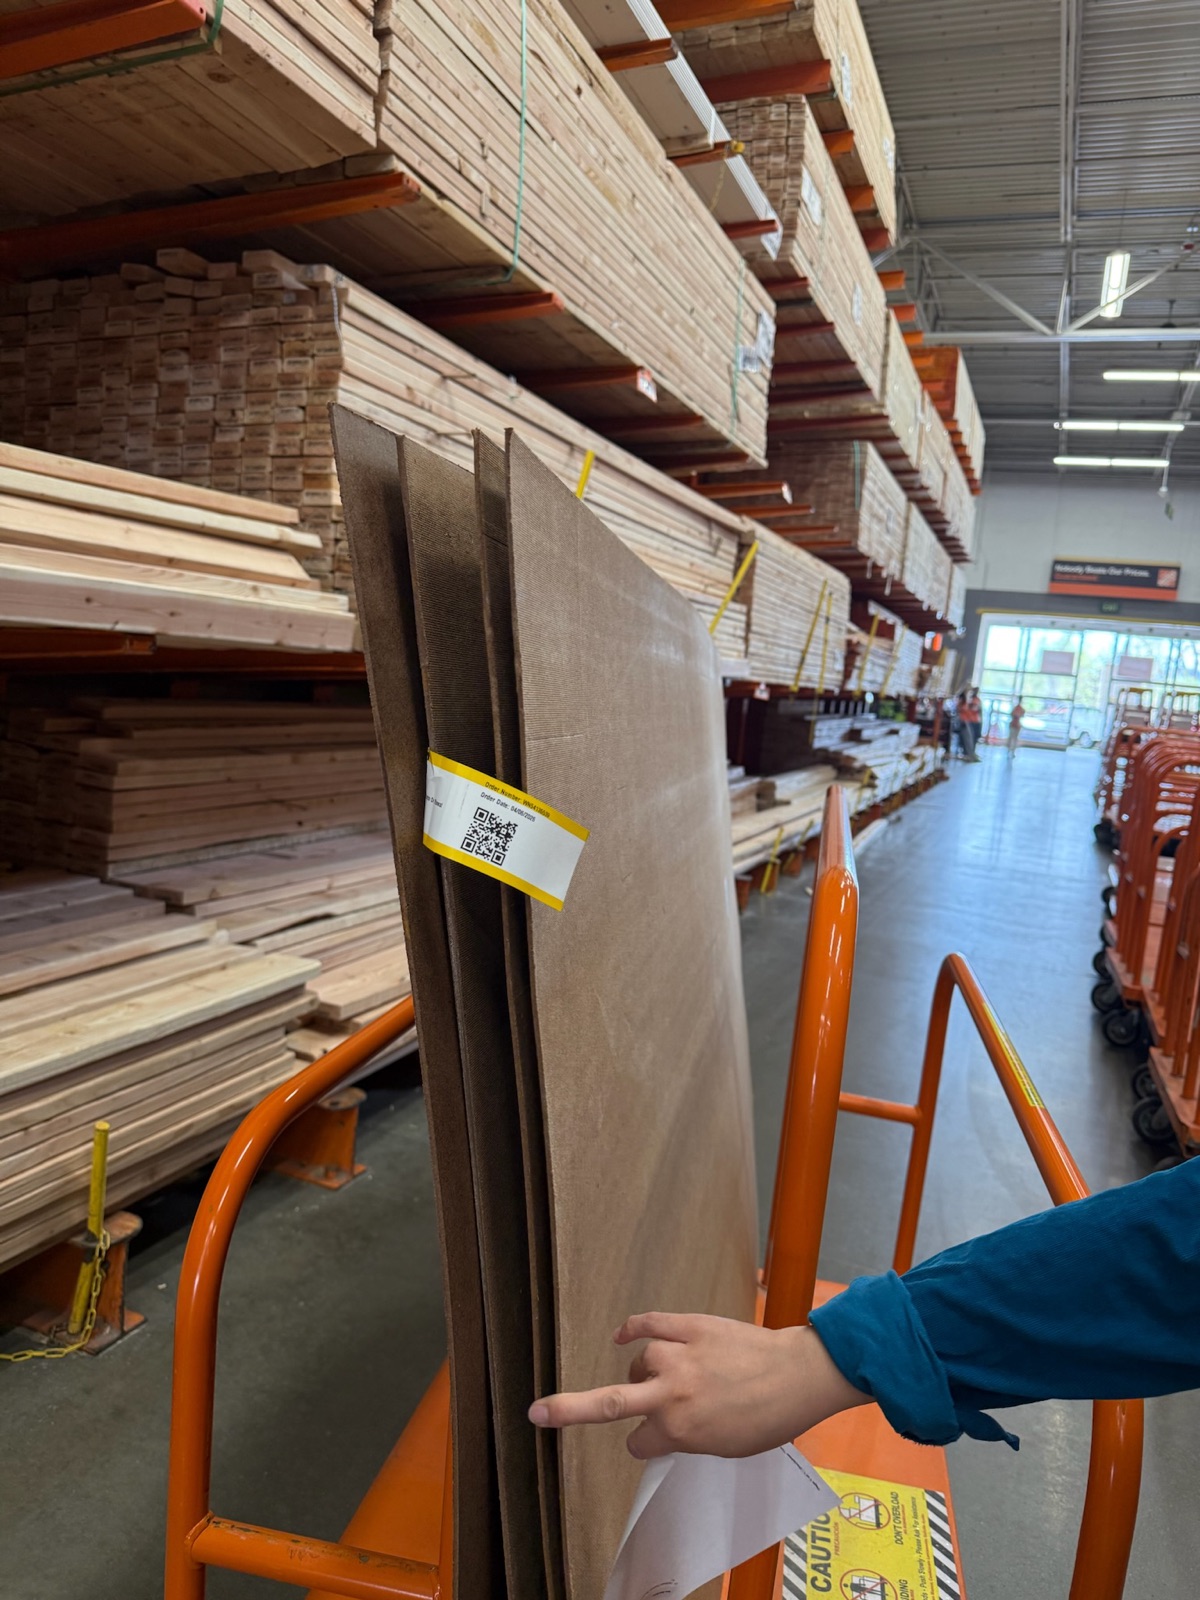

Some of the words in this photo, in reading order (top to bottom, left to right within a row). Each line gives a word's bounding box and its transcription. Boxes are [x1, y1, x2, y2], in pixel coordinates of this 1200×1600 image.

[485, 782, 500, 793] Order
[480, 792, 496, 802] Order
[496, 799, 509, 810] Date:
[891, 1491, 902, 1525] OVERLOAD
[893, 1524, 904, 1545] DON'T
[918, 1558, 926, 1575] Slowly
[919, 1575, 927, 1589] Push
